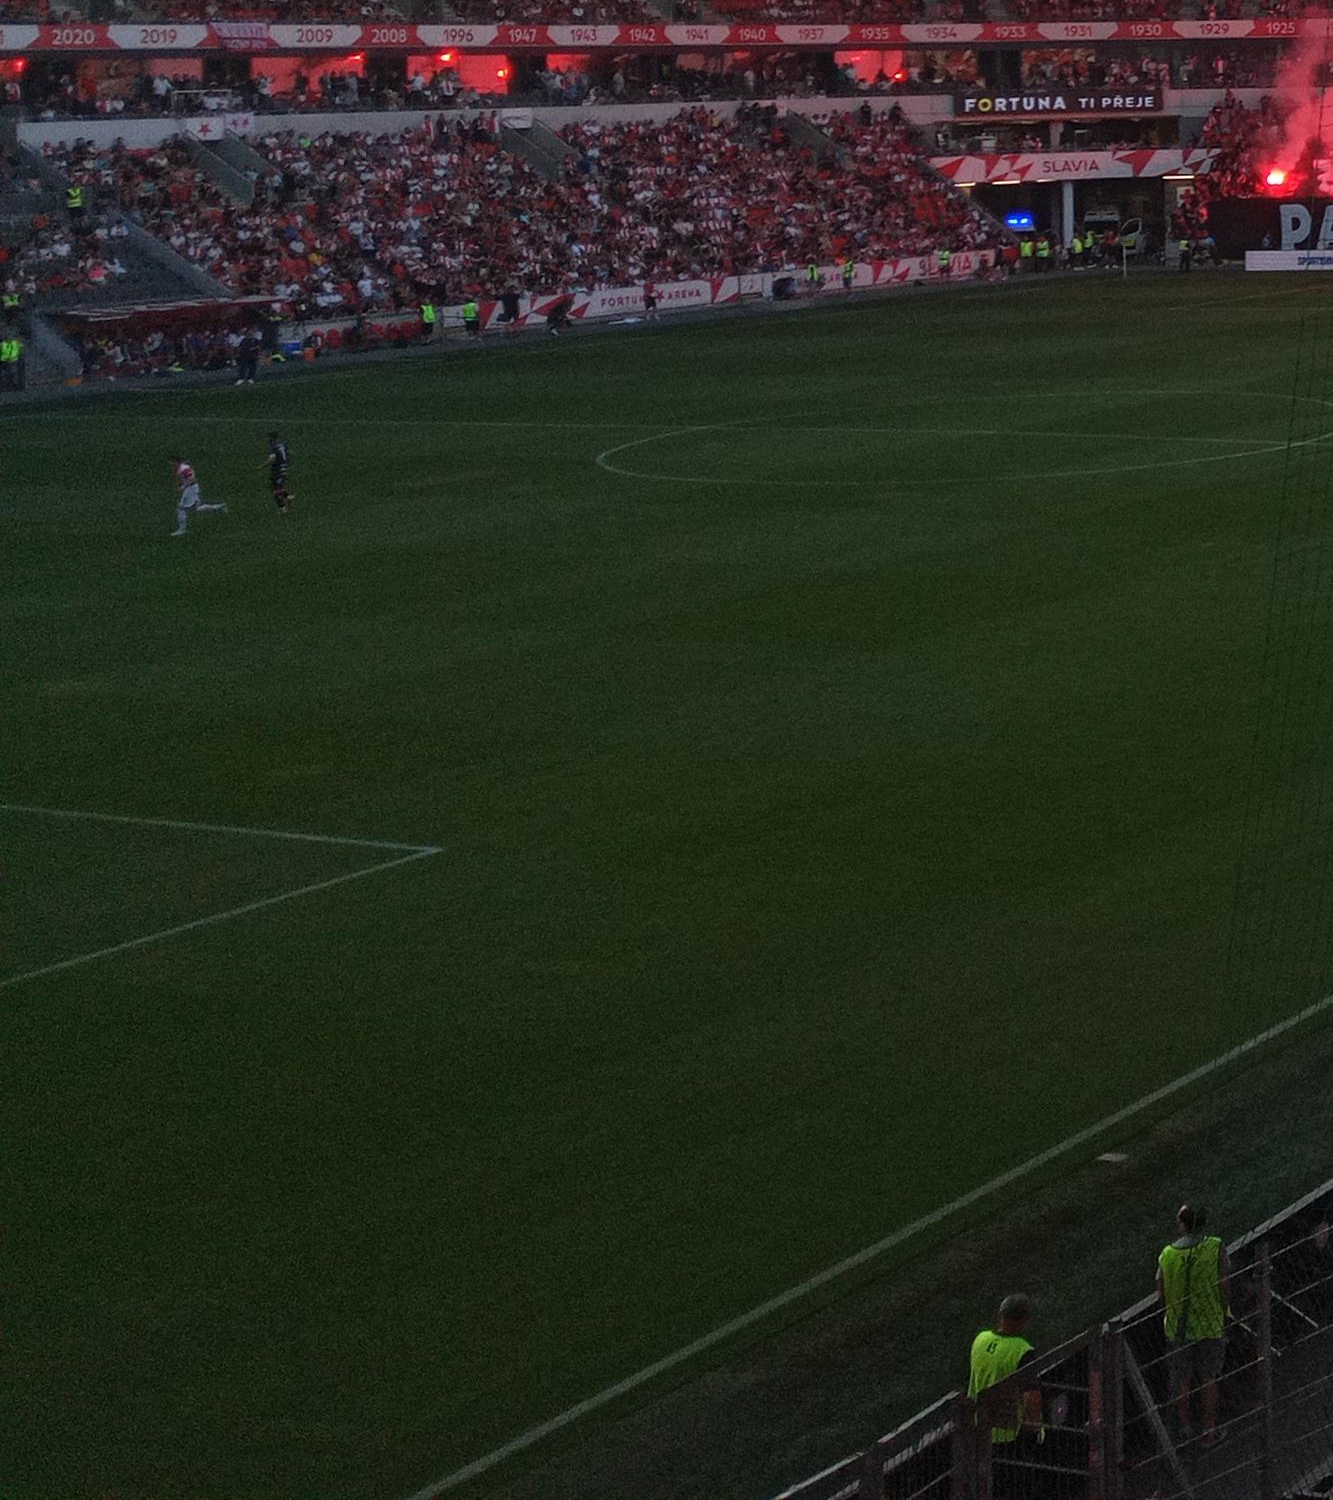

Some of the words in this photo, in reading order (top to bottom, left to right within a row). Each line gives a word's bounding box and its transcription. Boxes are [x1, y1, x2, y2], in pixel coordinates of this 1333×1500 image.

[52, 29, 95, 45] 2020
[140, 29, 177, 44] 2019
[296, 28, 333, 43] 2009
[371, 28, 407, 43] 2008
[442, 28, 473, 42] 1996
[508, 28, 536, 42] 1947
[570, 28, 597, 42] 1943
[629, 27, 655, 41] 1942
[739, 27, 766, 41] 1940
[859, 26, 889, 40] 1935
[926, 26, 957, 39] 1934
[1063, 24, 1093, 37] 1931
[1129, 24, 1162, 36] 1930
[1200, 23, 1230, 34] 1929
[1265, 21, 1296, 34] 1925
[964, 96, 1067, 112] FORTUNA
[1078, 97, 1094, 109] TI
[1102, 95, 1154, 109] PŘEJE
[1043, 160, 1099, 172] SLAVIA
[919, 255, 972, 277] SLVIA
